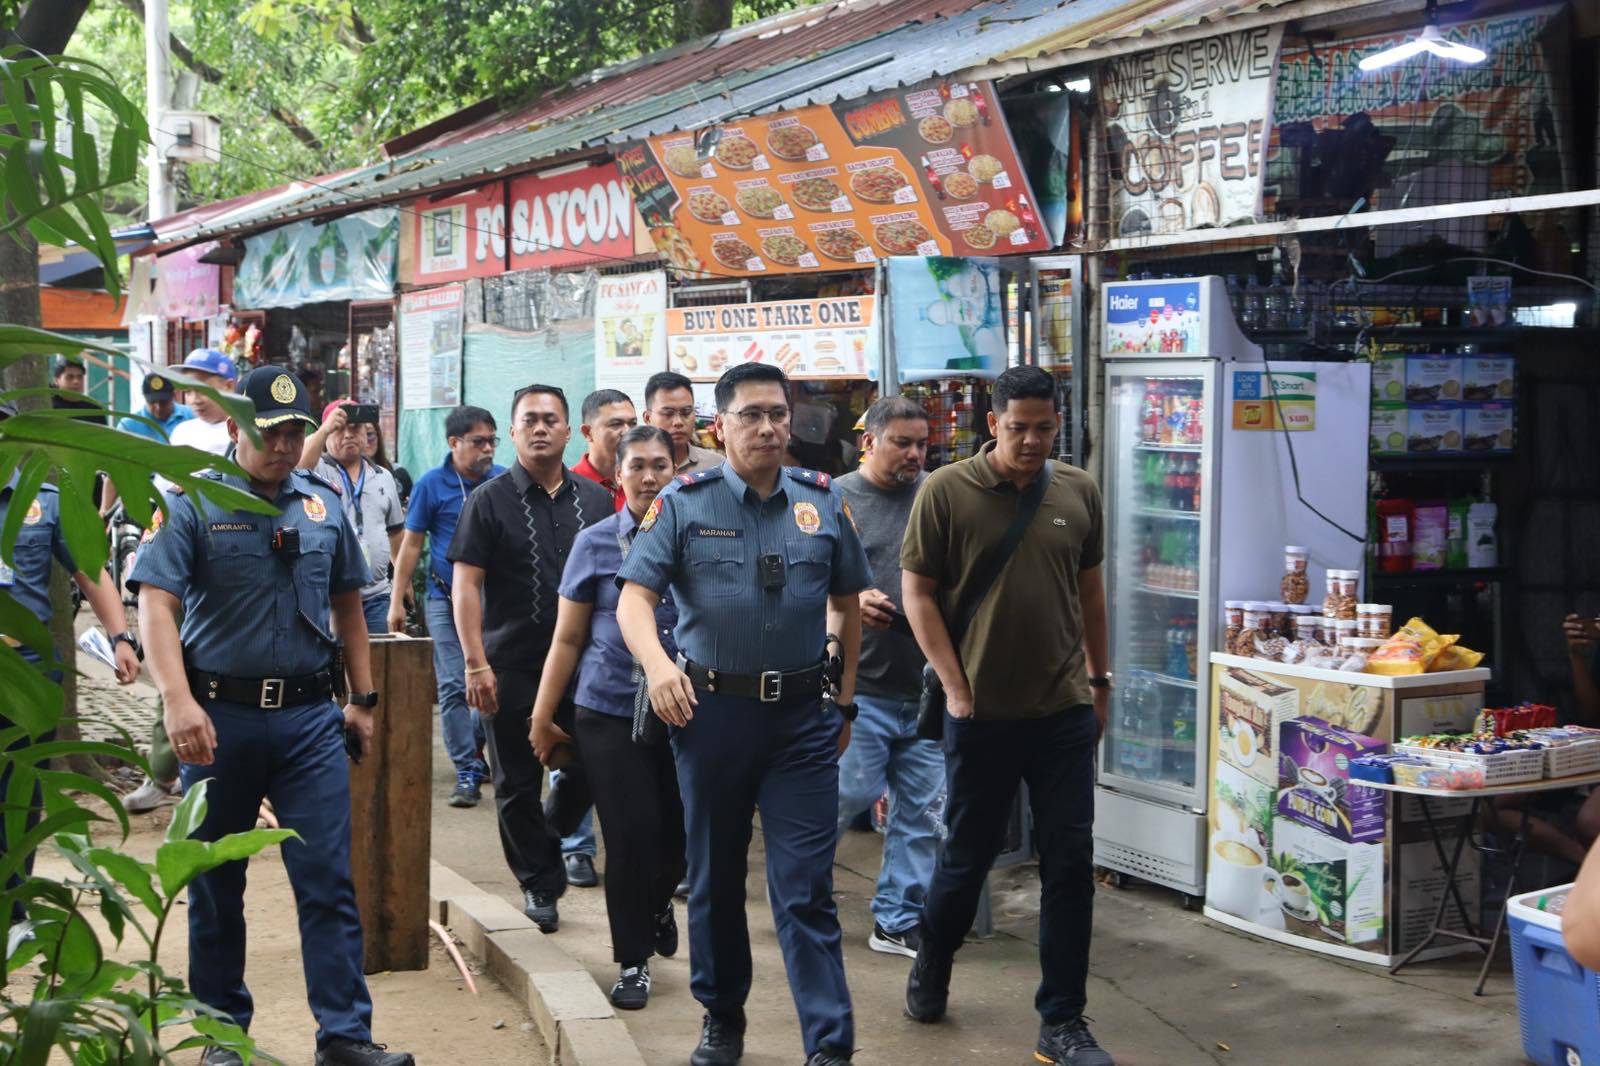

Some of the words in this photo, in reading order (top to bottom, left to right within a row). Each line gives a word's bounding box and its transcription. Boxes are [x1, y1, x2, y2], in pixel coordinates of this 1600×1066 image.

[1107, 53, 1158, 103] WE
[1167, 26, 1272, 93] SERVE
[512, 179, 631, 256] SAYCON
[1109, 293, 1139, 310] Haier
[684, 310, 716, 331] BUY
[721, 307, 758, 329] ONE
[762, 303, 812, 327] TAKE
[818, 301, 861, 324] ONE
[1279, 380, 1305, 390] Smart
[699, 528, 736, 537] MARANAN
[1315, 803, 1339, 829] CORN
